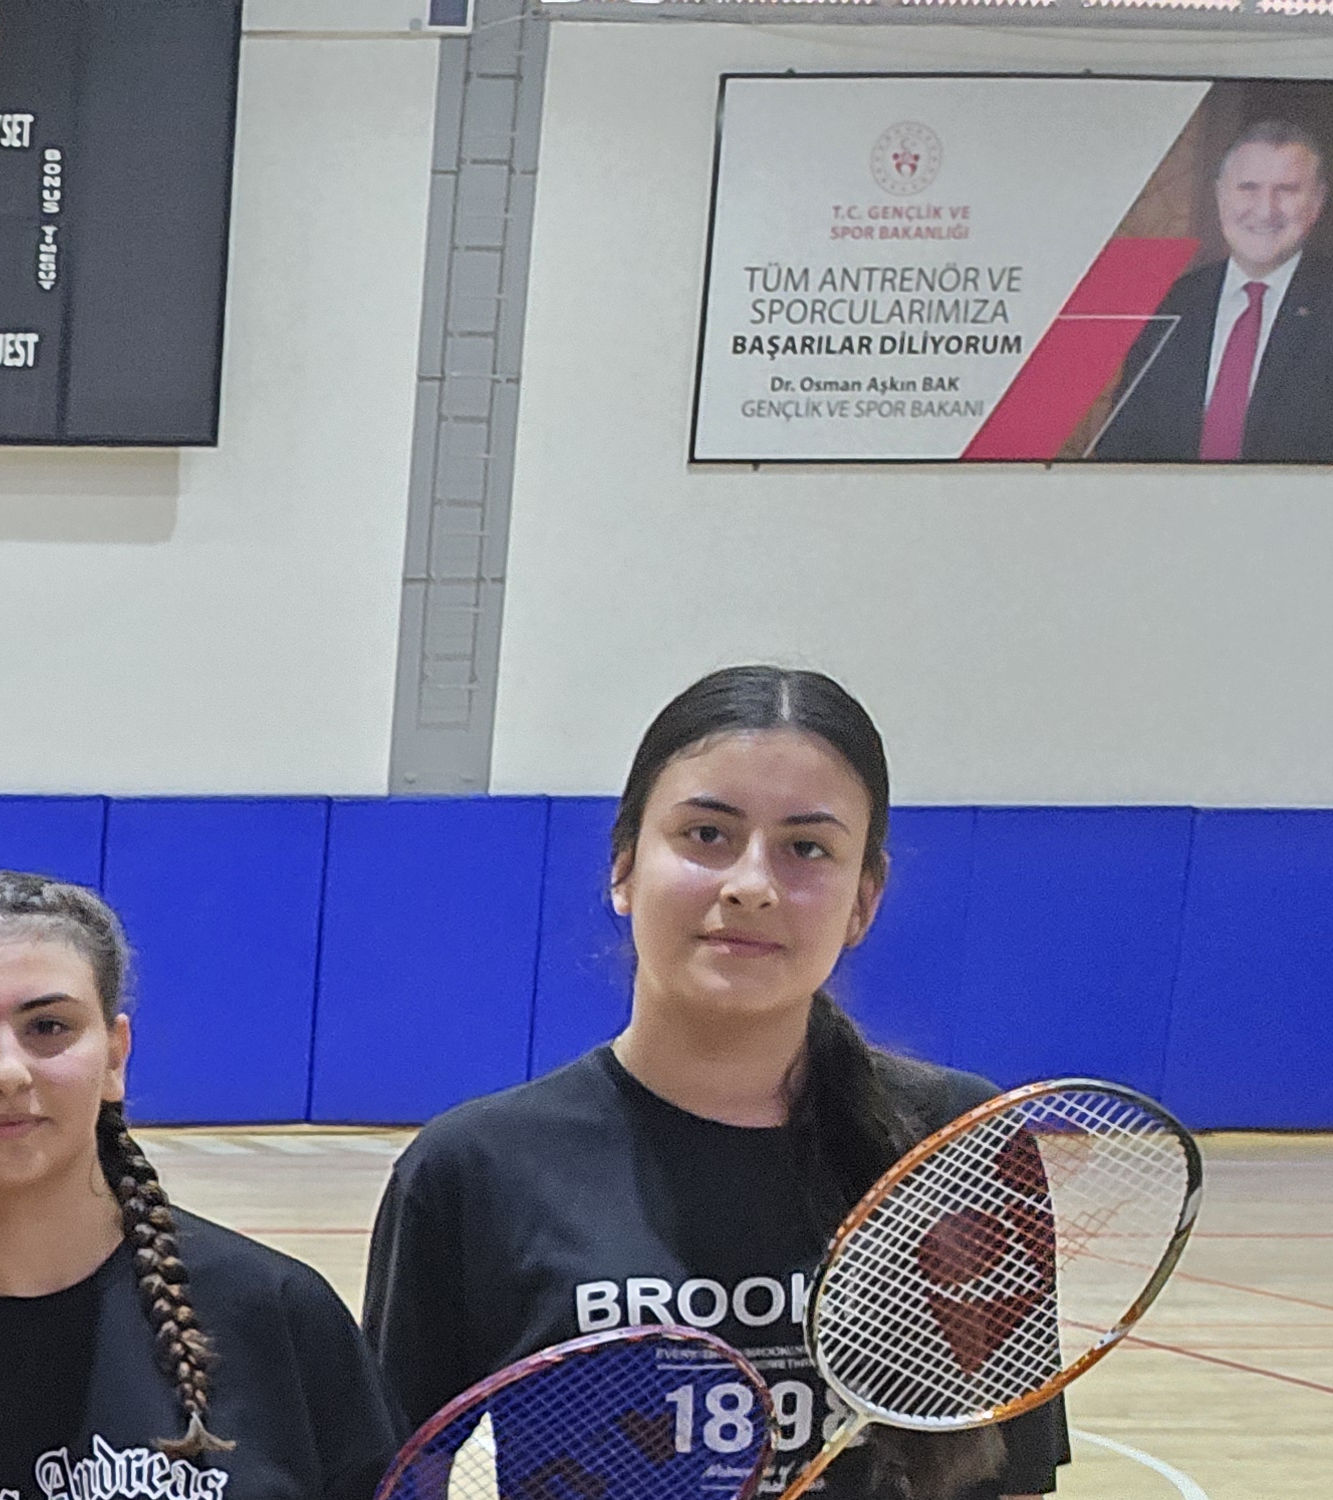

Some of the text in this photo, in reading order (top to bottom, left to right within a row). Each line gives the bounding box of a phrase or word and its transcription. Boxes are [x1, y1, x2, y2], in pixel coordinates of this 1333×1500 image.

[832, 203, 970, 222] T.C. GENÇLİK VE
[829, 222, 969, 240] SPOR BAKANLIĞI
[743, 262, 1023, 293] TÜM ANTRENÖR VE
[749, 298, 1009, 325] SPORCULARIMIZA
[731, 330, 1023, 360] BAŞARILAR DİLİYORUM
[770, 376, 960, 396] Dr. Osman Aşkın BAK
[740, 398, 984, 422] GENÇLİK VE SPOR BAKANI
